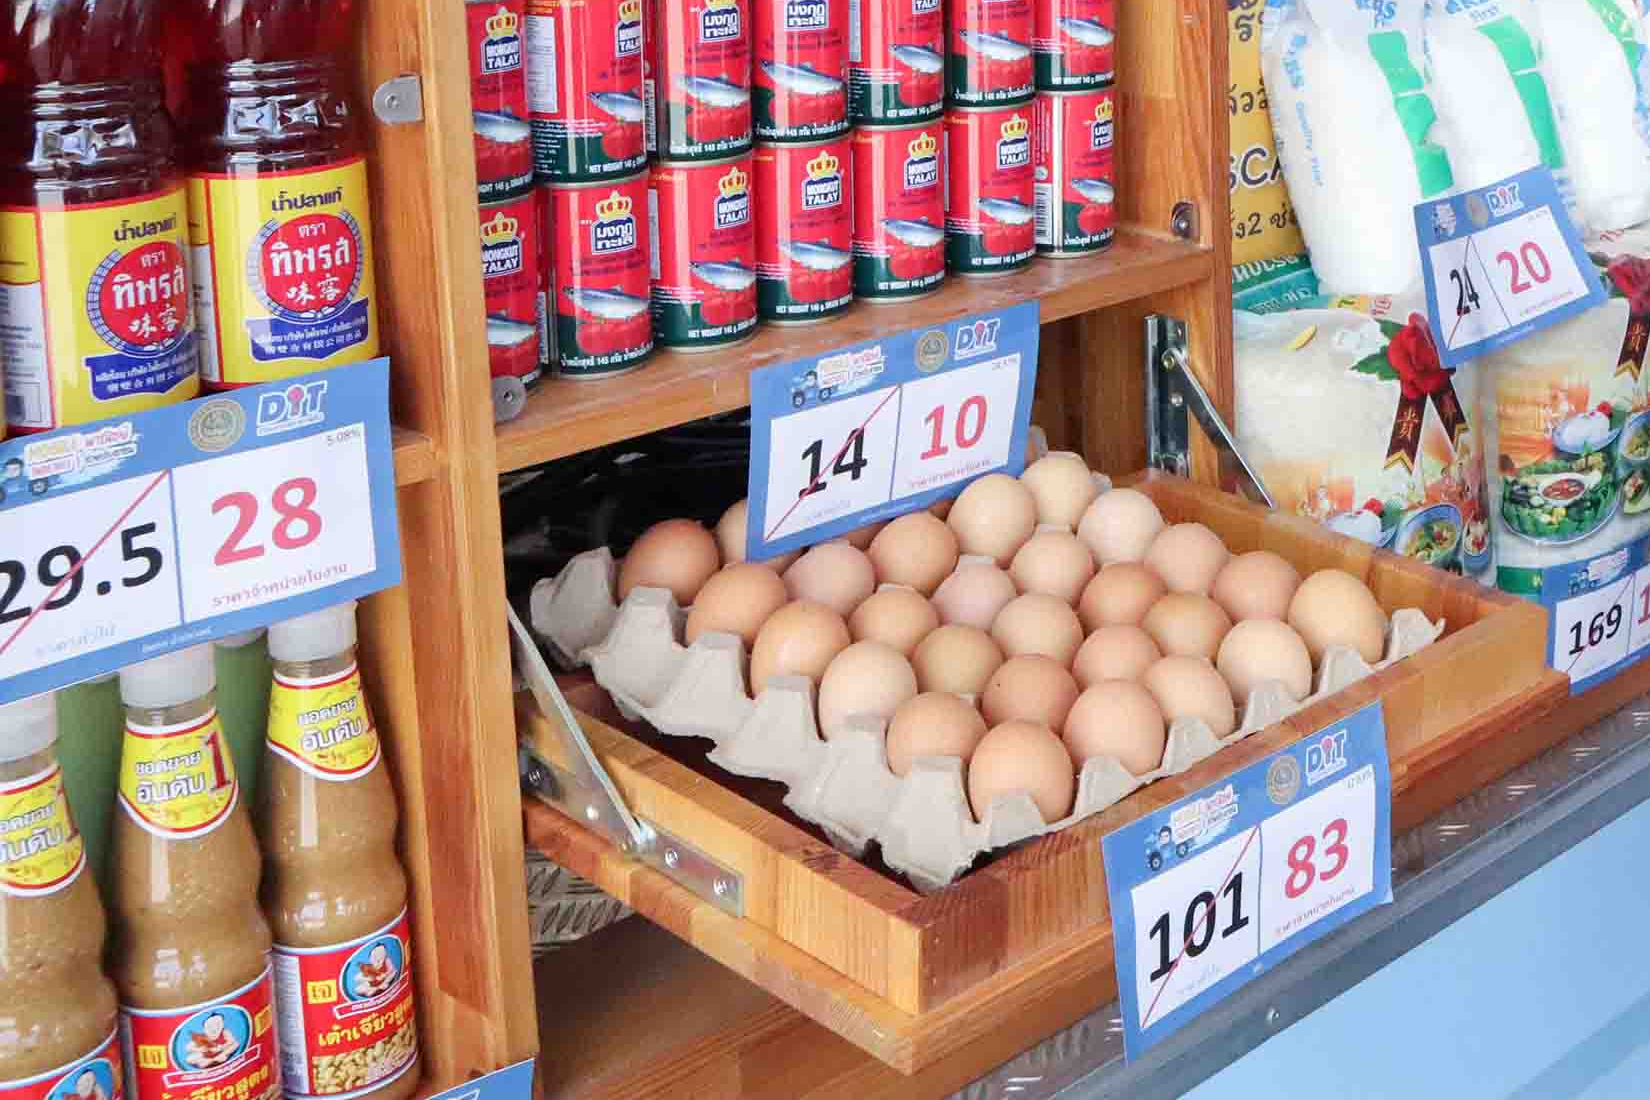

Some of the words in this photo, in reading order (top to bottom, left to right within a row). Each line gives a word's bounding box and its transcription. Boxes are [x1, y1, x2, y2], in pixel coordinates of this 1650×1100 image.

[487, 53, 521, 67] TALAY
[999, 153, 1029, 165] TALAY
[907, 172, 937, 184] TALAY
[805, 192, 840, 205] TALAY
[297, 221, 327, 237] ตรา
[718, 209, 749, 223] TALAY
[269, 242, 351, 276] ทิพรส
[111, 266, 186, 309] ทิพรส
[1449, 267, 1481, 317] 24
[1496, 241, 1553, 295] 20
[799, 426, 868, 499] 14
[919, 395, 989, 461] 10
[210, 477, 324, 567] 28
[1568, 603, 1623, 657] 169
[302, 720, 365, 750] อันดับ
[137, 772, 207, 805] อันดับ
[204, 730, 232, 792] 1
[0, 803, 56, 832] อดขาย
[1149, 871, 1250, 983] 101
[1284, 818, 1350, 900] 83
